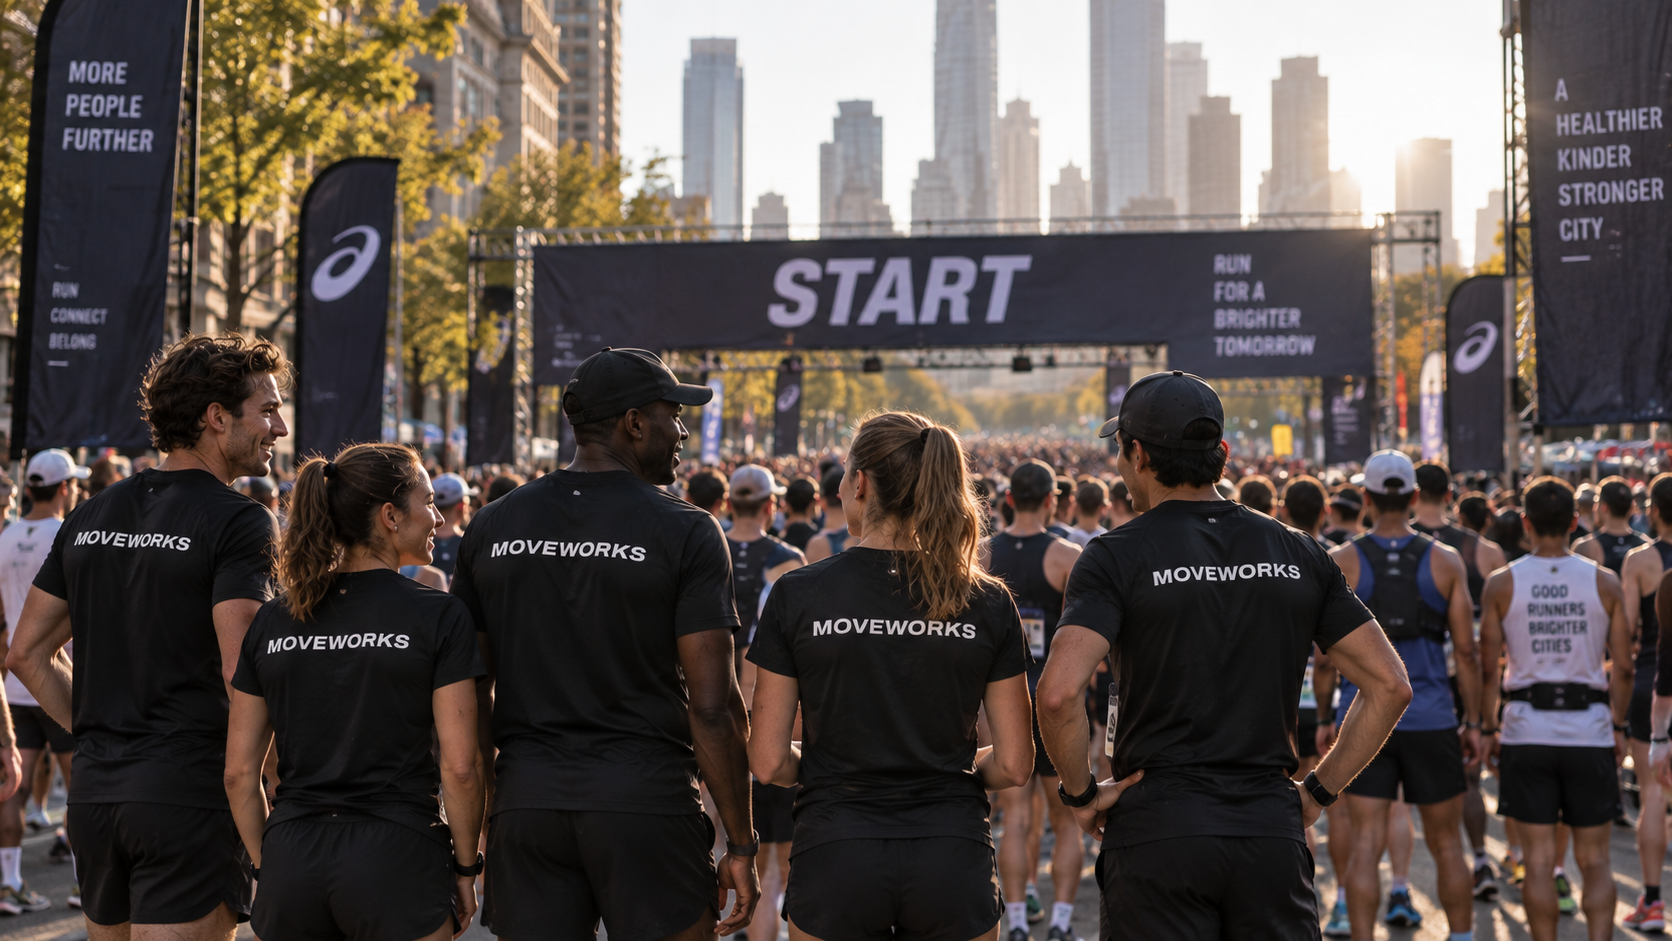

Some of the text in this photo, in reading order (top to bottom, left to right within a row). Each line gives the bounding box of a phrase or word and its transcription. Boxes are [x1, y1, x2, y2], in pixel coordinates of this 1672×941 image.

[68, 60, 128, 85] MORE
[1555, 78, 1569, 102] A
[65, 93, 143, 118] PEOPLE
[1556, 106, 1663, 136] HEALTHIER
[62, 127, 154, 152] FURTHER
[1558, 144, 1632, 172] KINDER
[1558, 177, 1664, 207] STRONGER
[1559, 216, 1604, 242] CITY
[1213, 254, 1252, 275] RUN
[52, 281, 80, 299] RUN
[767, 254, 1033, 329] START
[1213, 280, 1265, 302] FOR A
[50, 307, 108, 325] CONNECT
[1213, 307, 1302, 330] BRIGHTER
[49, 333, 97, 350] BELONG
[1213, 334, 1316, 357] TOMORROW
[73, 530, 191, 551] MOVEWORKS
[491, 539, 647, 562] MOVEWORKS
[1152, 562, 1301, 587] MOVEWORKS
[1531, 584, 1568, 599] GOOD
[1527, 602, 1586, 617] RUNNERS
[812, 618, 977, 640] MOVEWORKS
[1528, 620, 1588, 636] BRIGHTER
[266, 632, 411, 655] MOVEWORKS
[1531, 638, 1572, 654] CITIES
